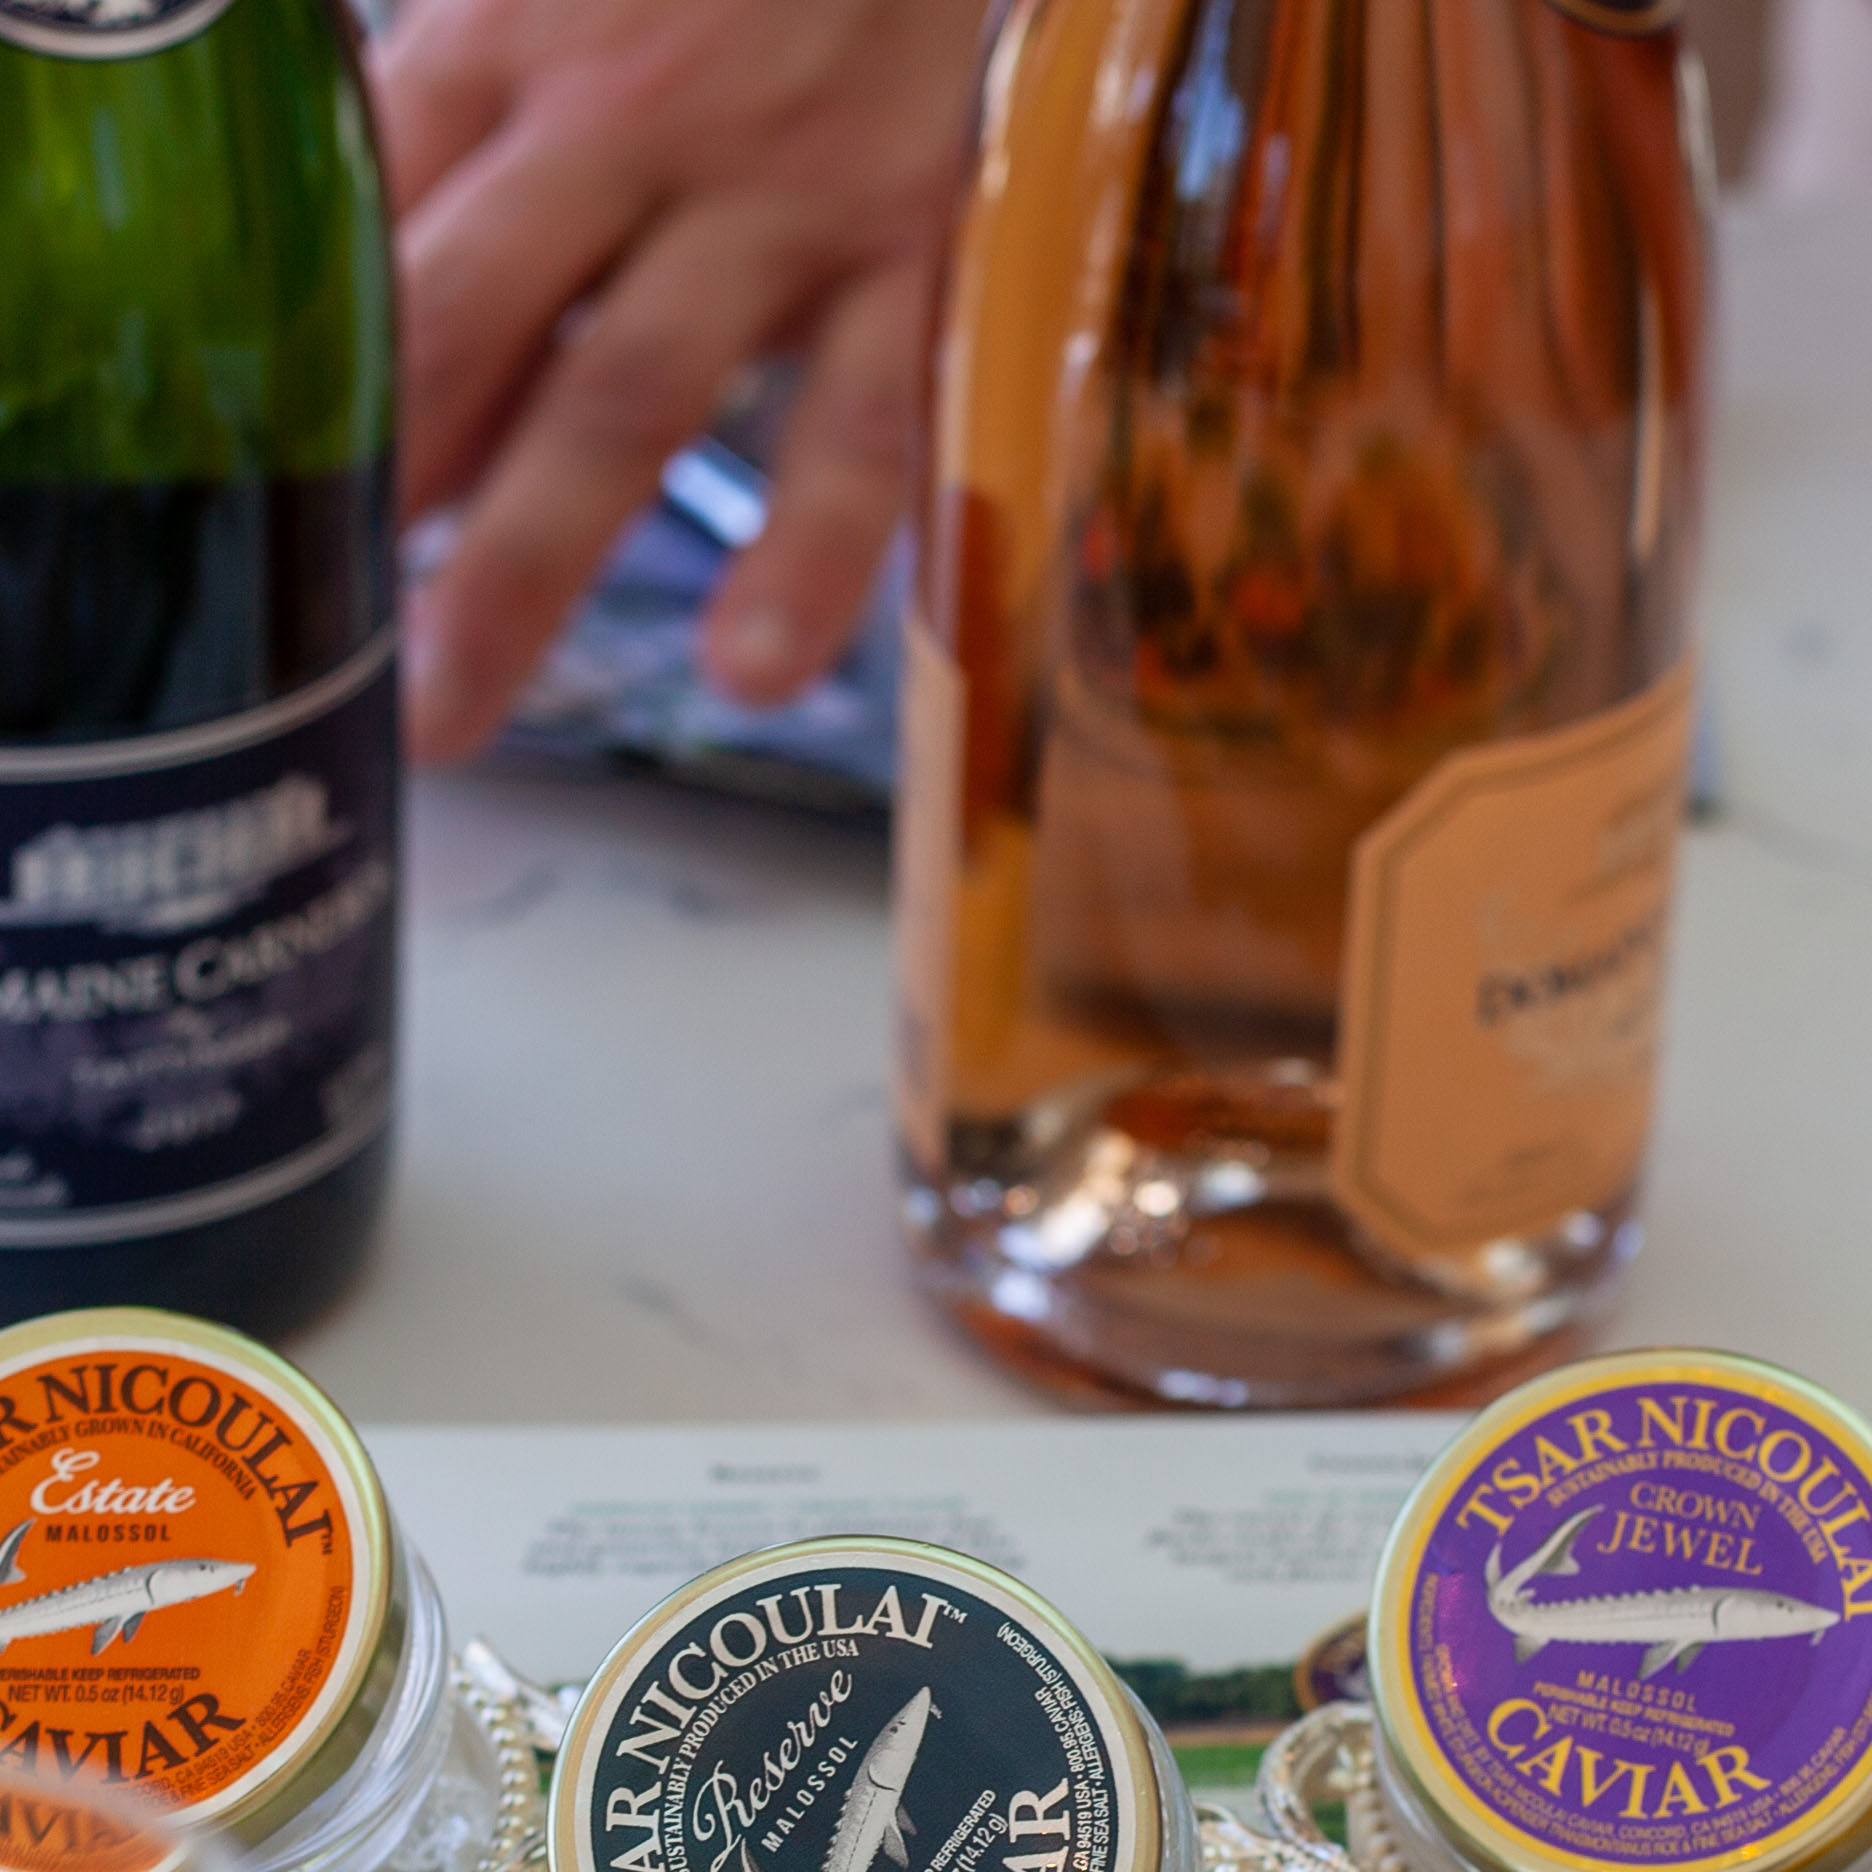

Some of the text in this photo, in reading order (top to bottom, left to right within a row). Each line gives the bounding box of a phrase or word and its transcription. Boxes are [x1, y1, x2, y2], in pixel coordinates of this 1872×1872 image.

[75, 1416, 145, 1437] GROWN
[147, 1420, 171, 1439] IN
[170, 1426, 258, 1501] CALIFORNIA
[1455, 1408, 1630, 1537] TSAR
[1662, 1452, 1762, 1492] PRODUCED
[30, 1447, 197, 1515] Estate
[1629, 1480, 1761, 1531] CROWN
[44, 1523, 171, 1542] MALOSSOL
[1596, 1510, 1764, 1576] JEWEL
[71, 1667, 104, 1680] KEEP
[107, 1667, 201, 1681] REFRIGERATED
[996, 1621, 1062, 1686] (STURGEON)
[7, 1685, 41, 1701] NET
[100, 1687, 119, 1700] oz
[678, 1670, 757, 1760] PRODUCED
[753, 1656, 780, 1682] IN
[778, 1641, 821, 1671] THE
[822, 1638, 860, 1660] USA
[1050, 1680, 1078, 1710] FISH
[1576, 1669, 1697, 1713] MALOSSOL
[1547, 1702, 1579, 1726] NET
[1487, 1698, 1773, 1820] CAVIAR
[760, 1736, 859, 1853] MALOSSOL
[1073, 1780, 1093, 1811] USA
[1092, 1788, 1110, 1817] SALT
[929, 1789, 997, 1872] REFRIGERATED
[988, 1812, 1010, 1836] g)
[1076, 1812, 1093, 1849] 94519
[1093, 1817, 1110, 1845] SEA
